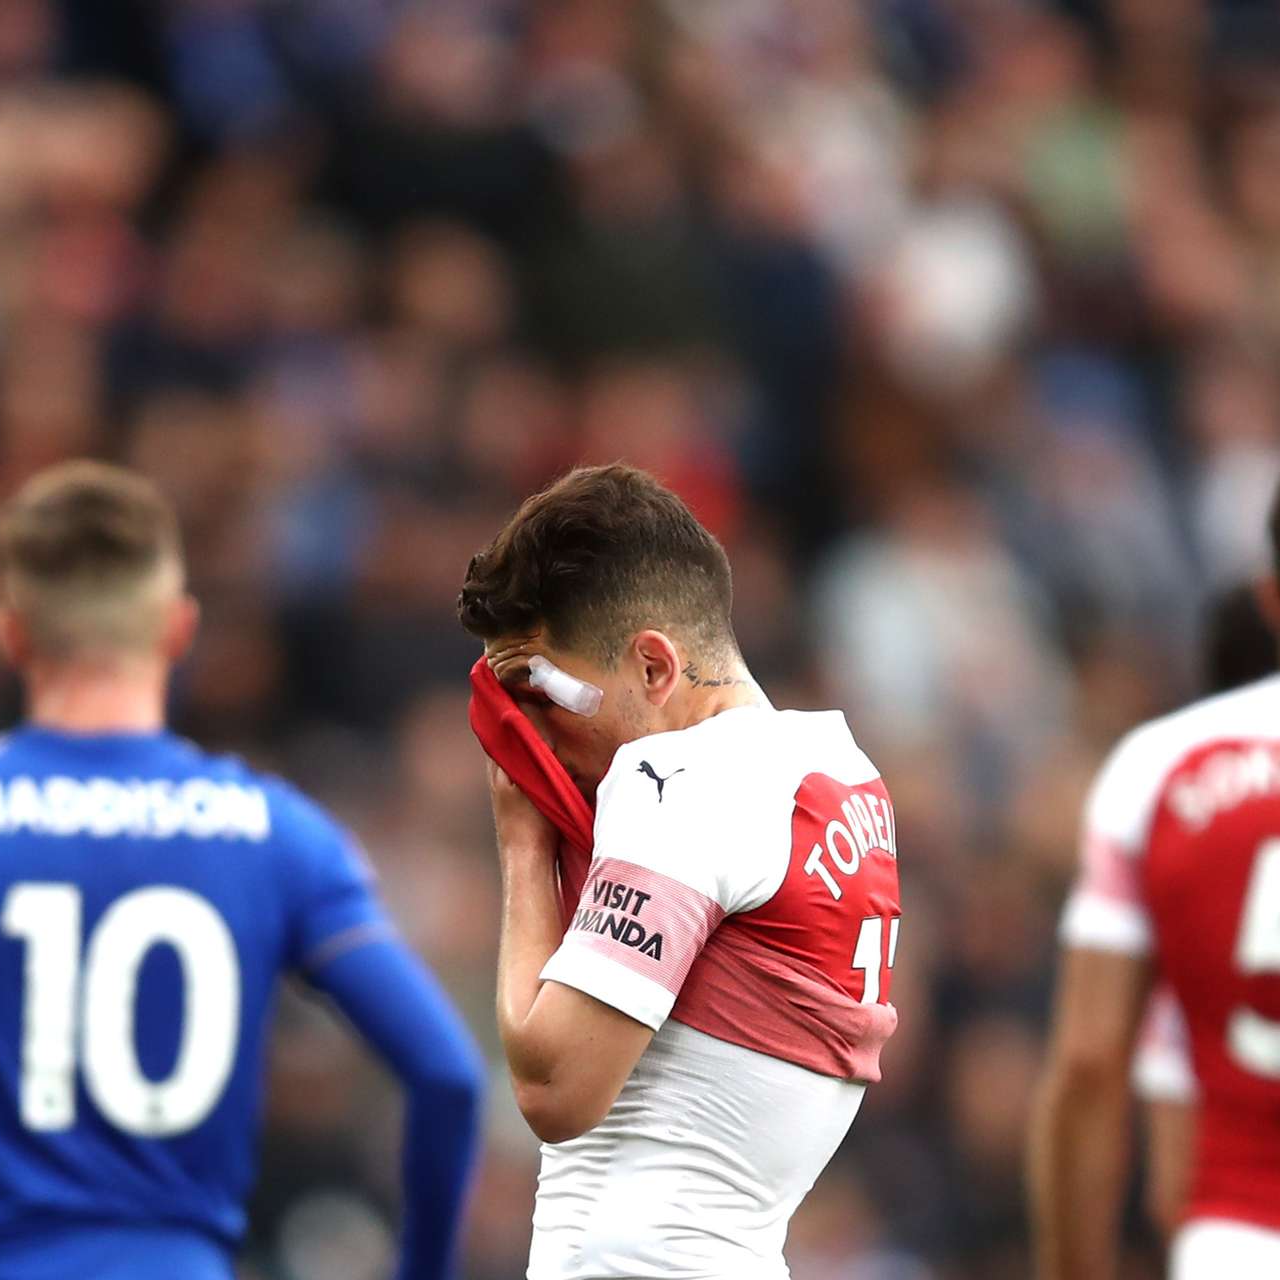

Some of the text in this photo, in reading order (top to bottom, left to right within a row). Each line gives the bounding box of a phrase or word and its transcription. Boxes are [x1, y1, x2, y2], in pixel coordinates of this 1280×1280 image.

[803, 793, 897, 901] TORREI
[592, 879, 652, 917] VISIT
[570, 907, 663, 961] WANDA
